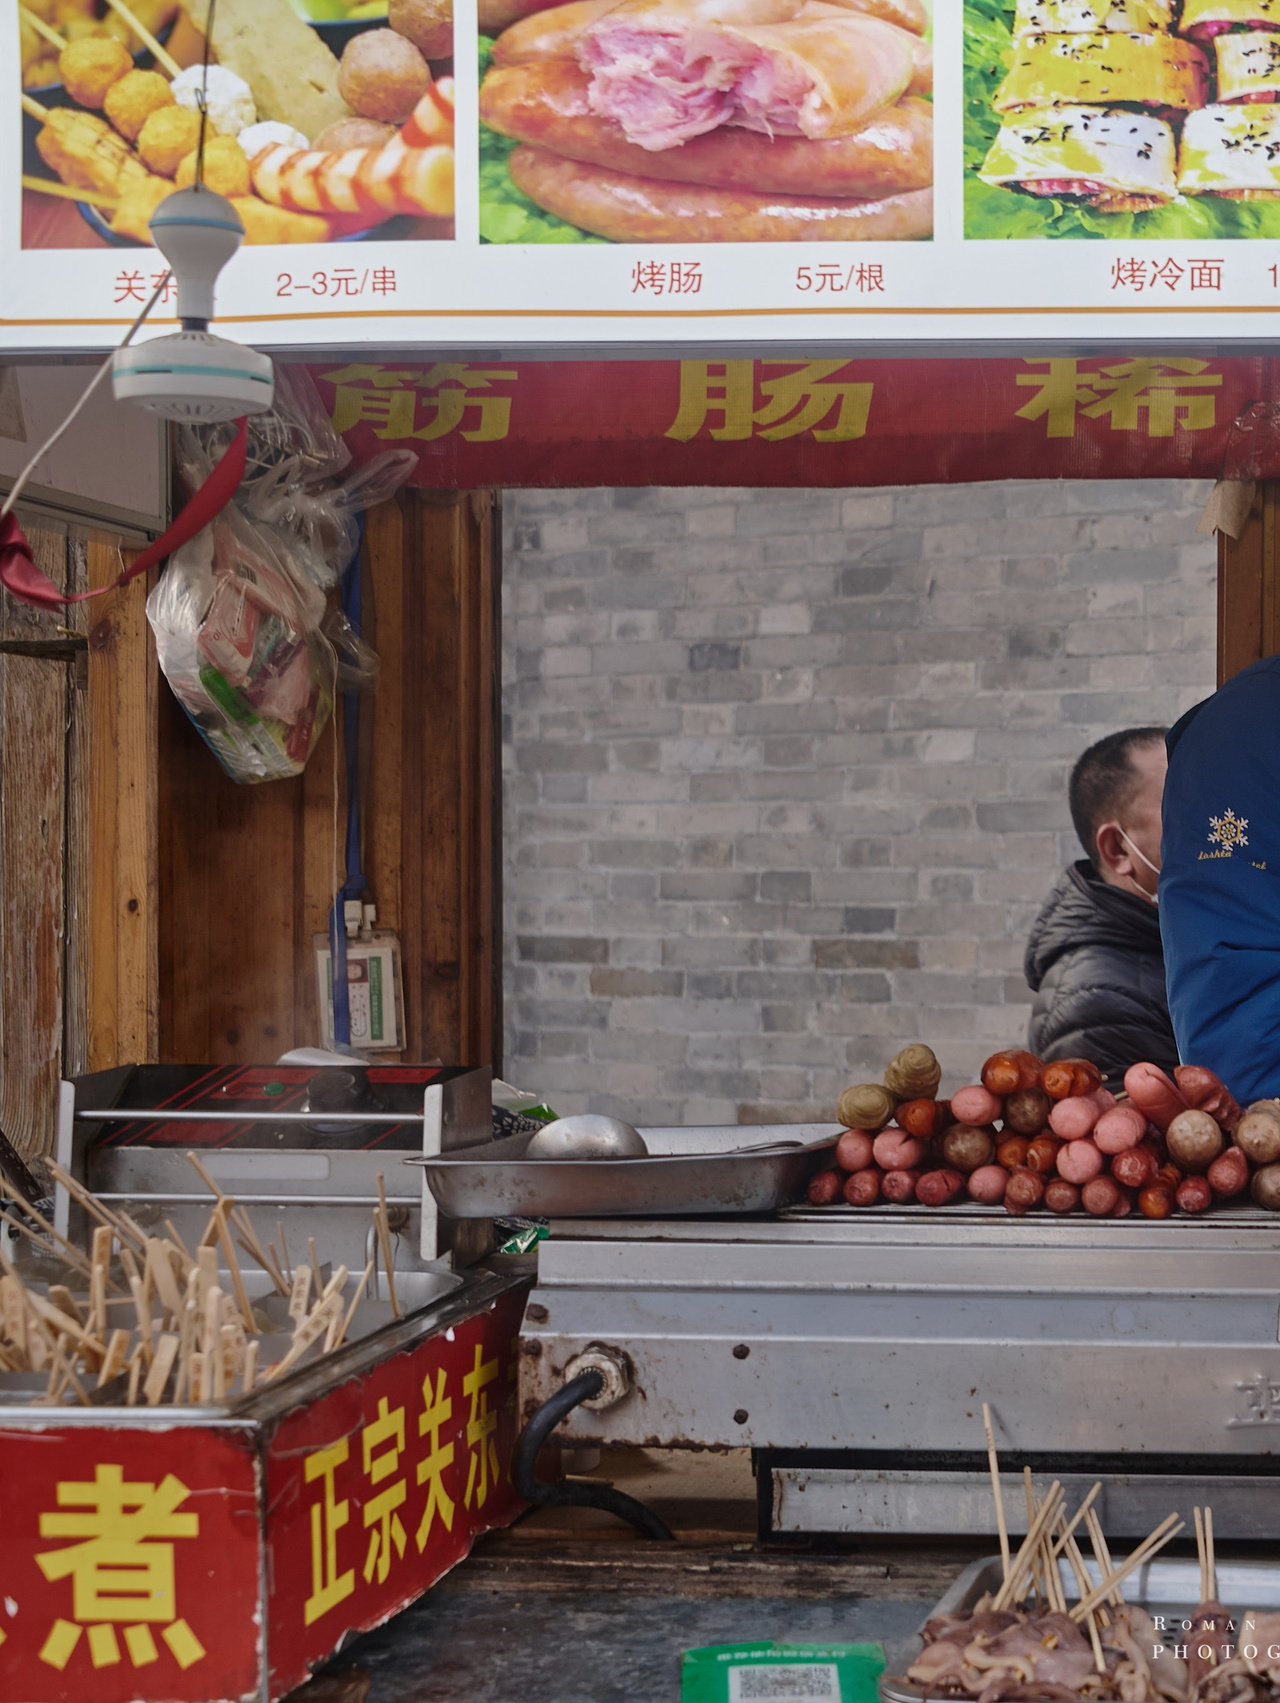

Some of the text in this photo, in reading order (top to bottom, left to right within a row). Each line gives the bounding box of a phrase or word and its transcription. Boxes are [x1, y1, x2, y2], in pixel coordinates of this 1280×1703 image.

[113, 269, 217, 304] 关东
[631, 260, 886, 296] 烤肠 5元/根
[1110, 257, 1225, 292] 烤冷面
[318, 357, 1223, 443] 筋 肠 稀
[304, 1337, 520, 1627] 正宗关东
[0, 1464, 207, 1671] 煮
